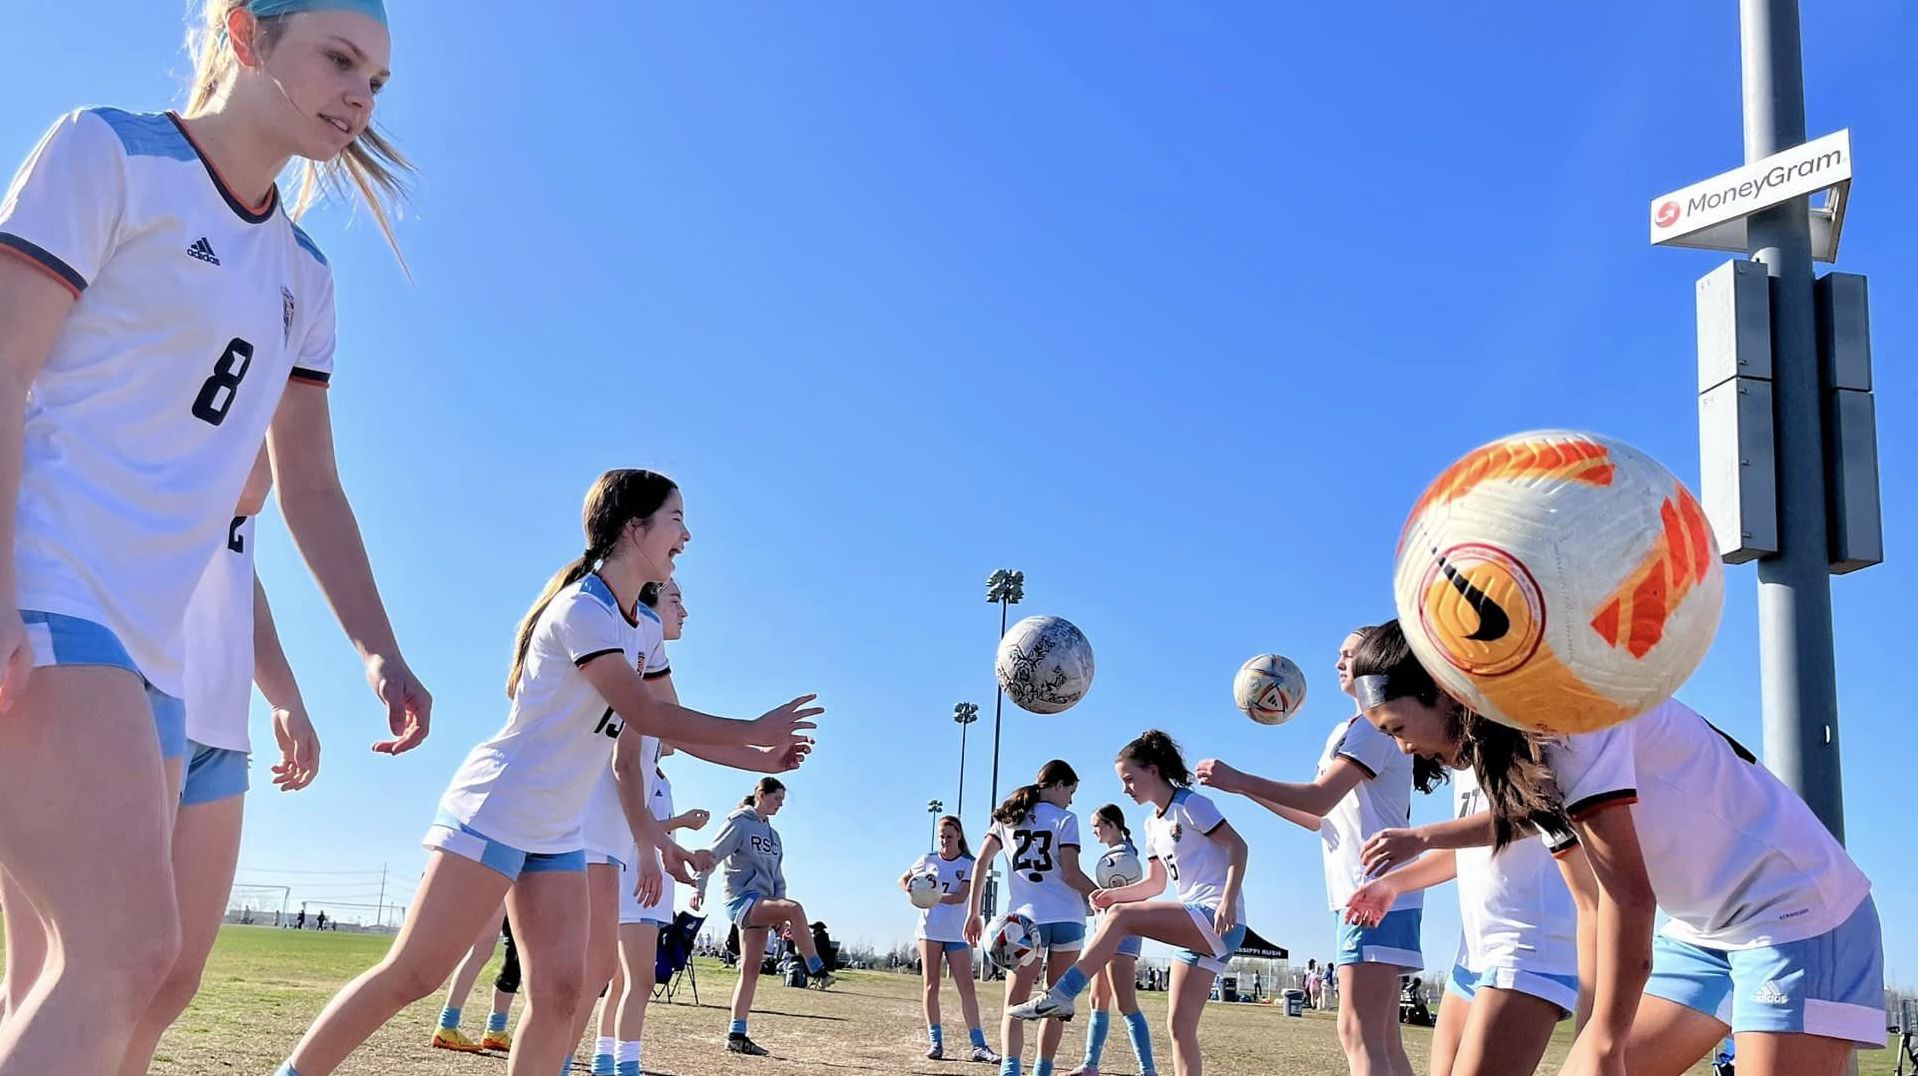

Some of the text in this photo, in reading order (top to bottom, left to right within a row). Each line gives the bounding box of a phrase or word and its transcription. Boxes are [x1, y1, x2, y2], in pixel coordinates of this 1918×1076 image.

[1686, 149, 1842, 218] MoneyGram
[186, 248, 221, 267] adidas
[191, 336, 254, 427] 8
[1012, 829, 1053, 873] 23
[941, 881, 951, 894] 7
[1261, 949, 1281, 957] RUSH
